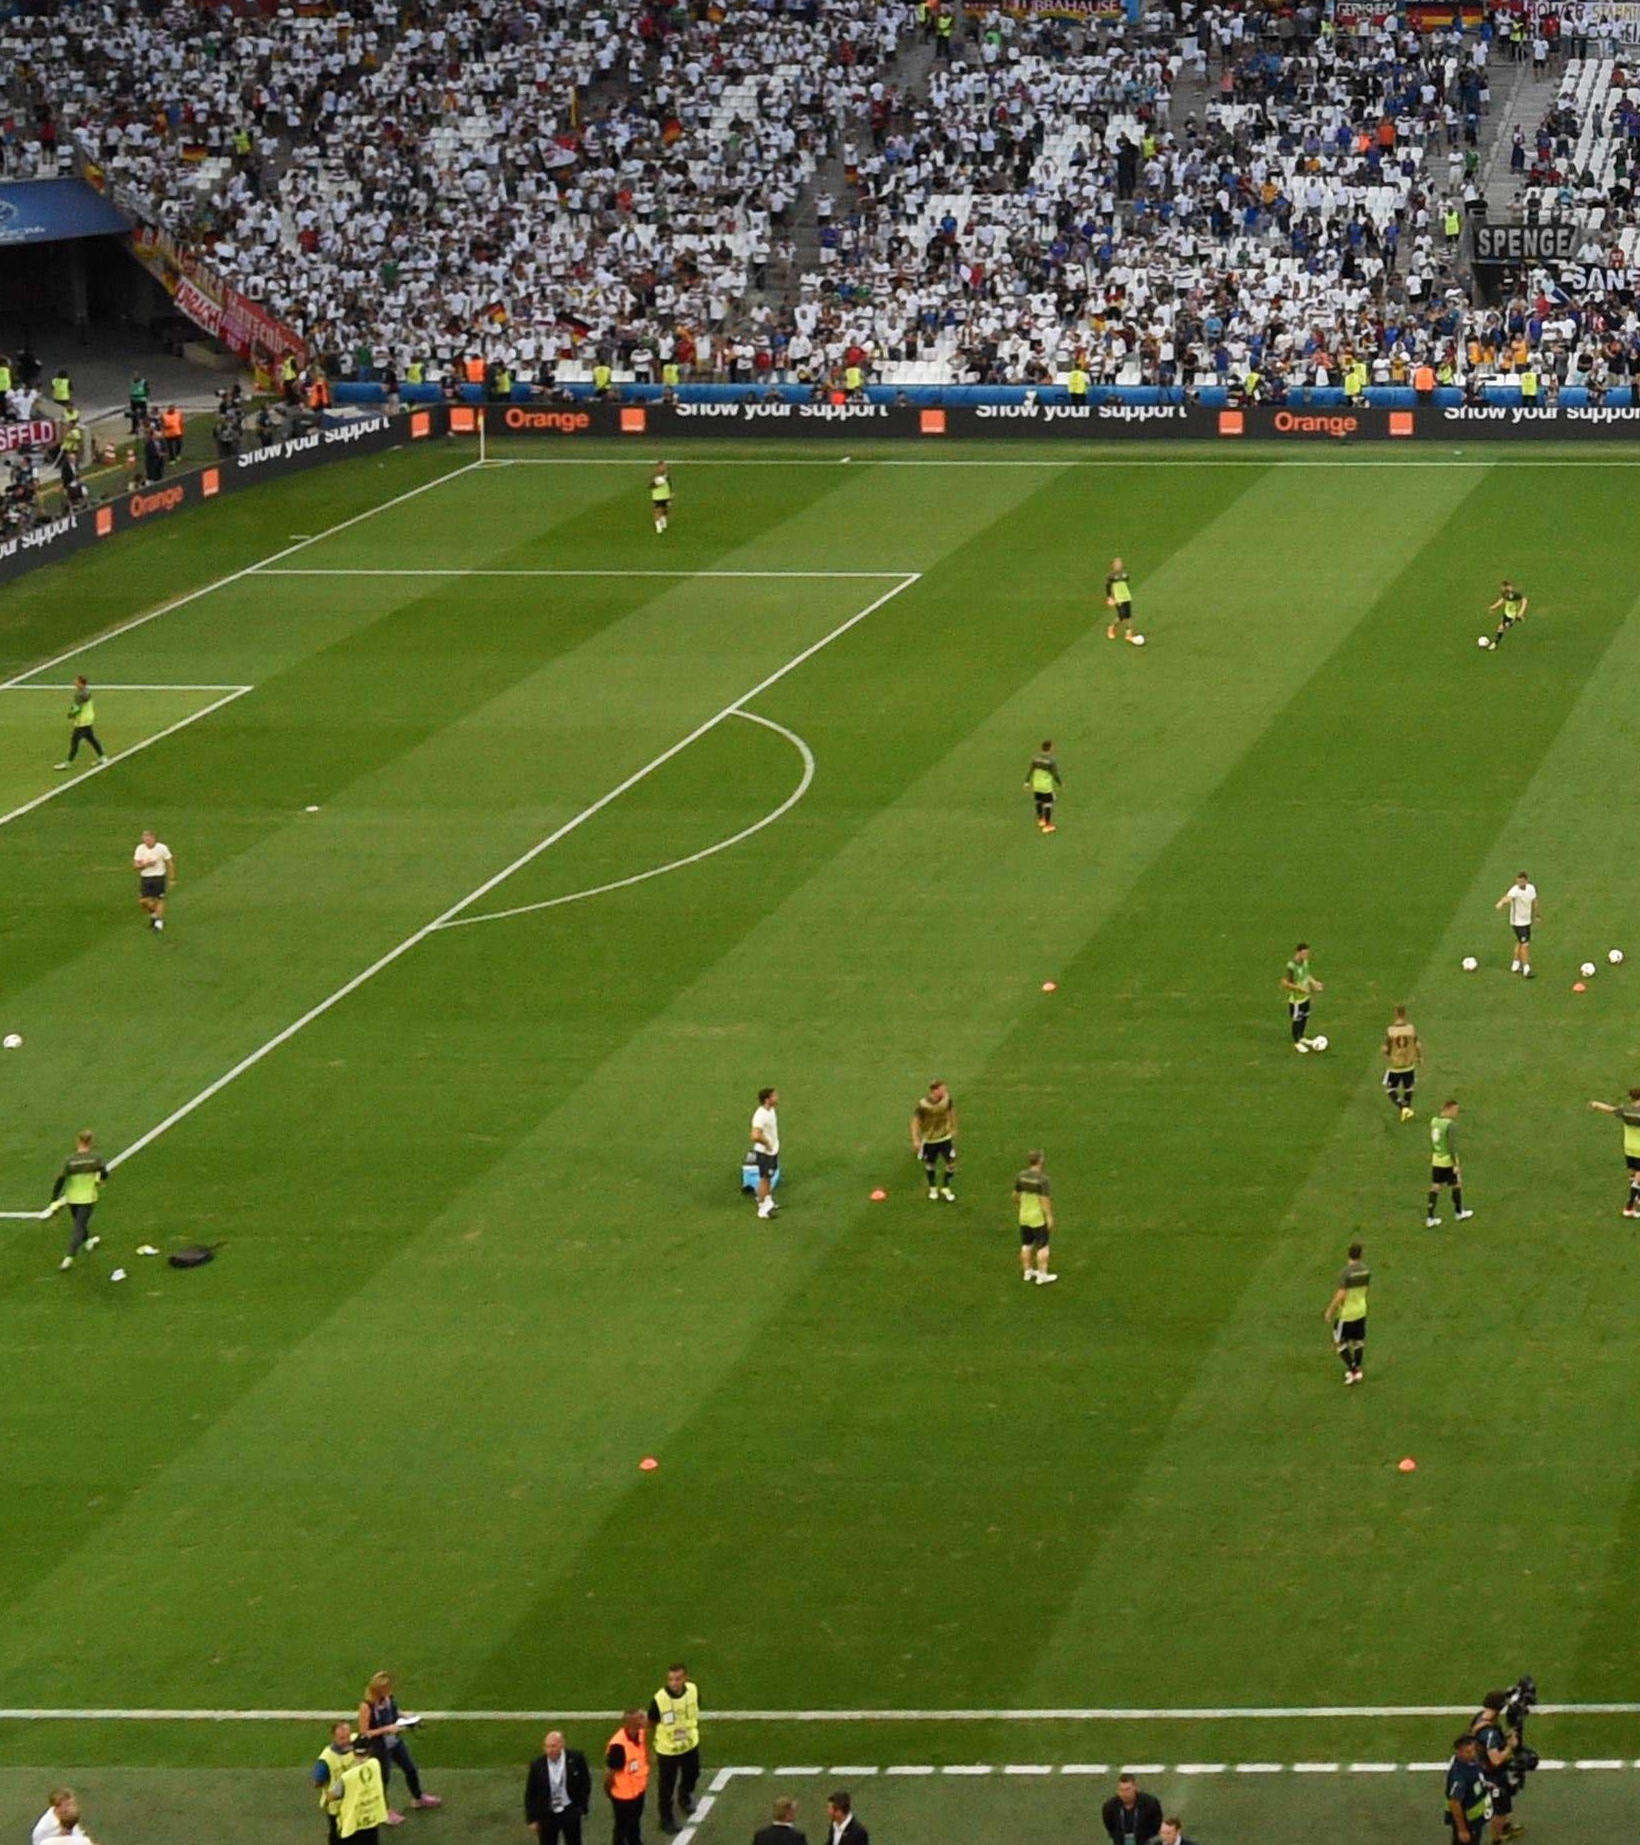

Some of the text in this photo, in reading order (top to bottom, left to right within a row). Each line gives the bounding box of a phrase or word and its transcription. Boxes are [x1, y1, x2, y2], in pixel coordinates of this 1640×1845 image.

[1477, 227, 1570, 257] SPENGE
[505, 409, 589, 431] Orange
[1274, 411, 1358, 436] Orange
[129, 483, 185, 519] Orange
